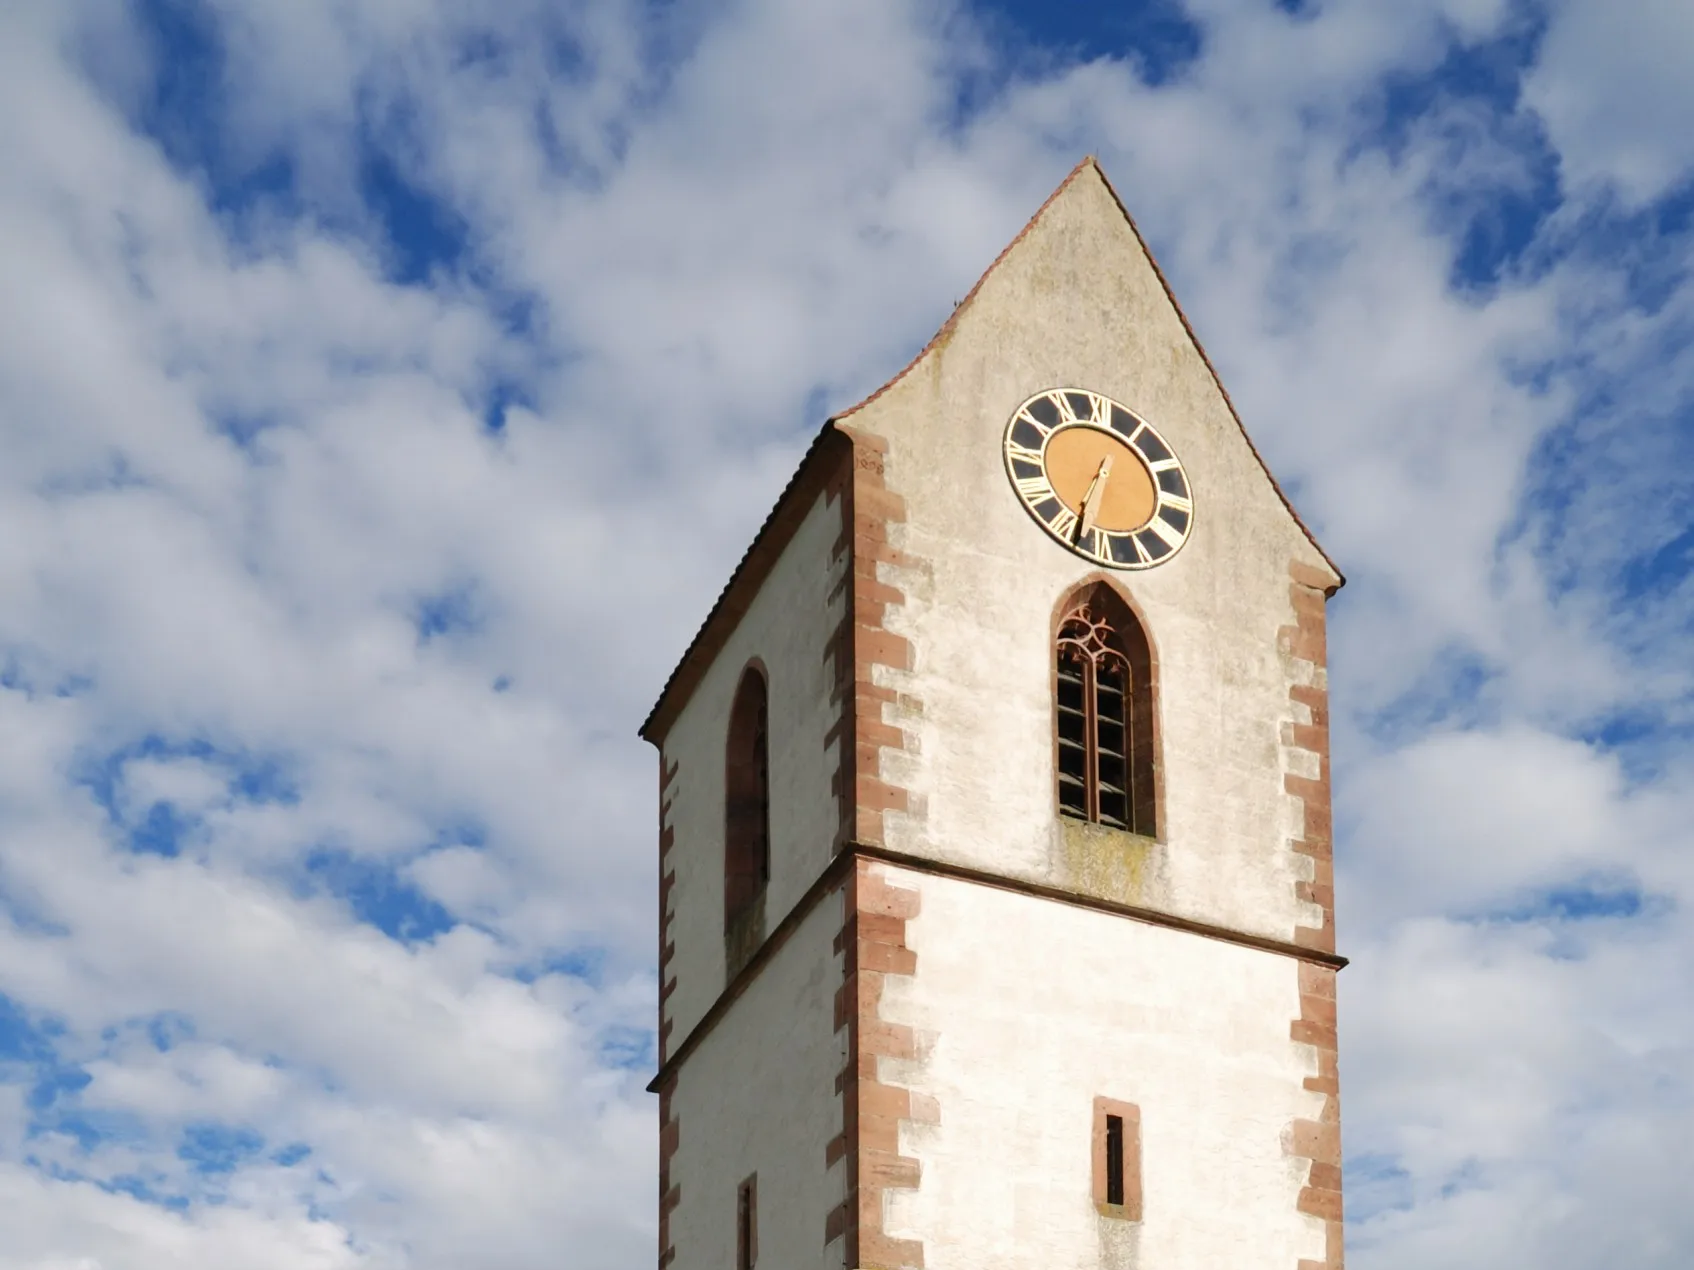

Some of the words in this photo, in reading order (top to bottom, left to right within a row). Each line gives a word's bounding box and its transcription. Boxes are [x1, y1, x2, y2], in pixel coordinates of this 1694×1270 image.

[1018, 408, 1053, 437] X
[1047, 392, 1078, 423] XI
[1088, 392, 1112, 427] XII
[1127, 421, 1147, 443] I
[1008, 440, 1043, 466] IX
[1016, 476, 1055, 507] VIII
[1095, 528, 1113, 562] VI
[1131, 533, 1154, 563] V
